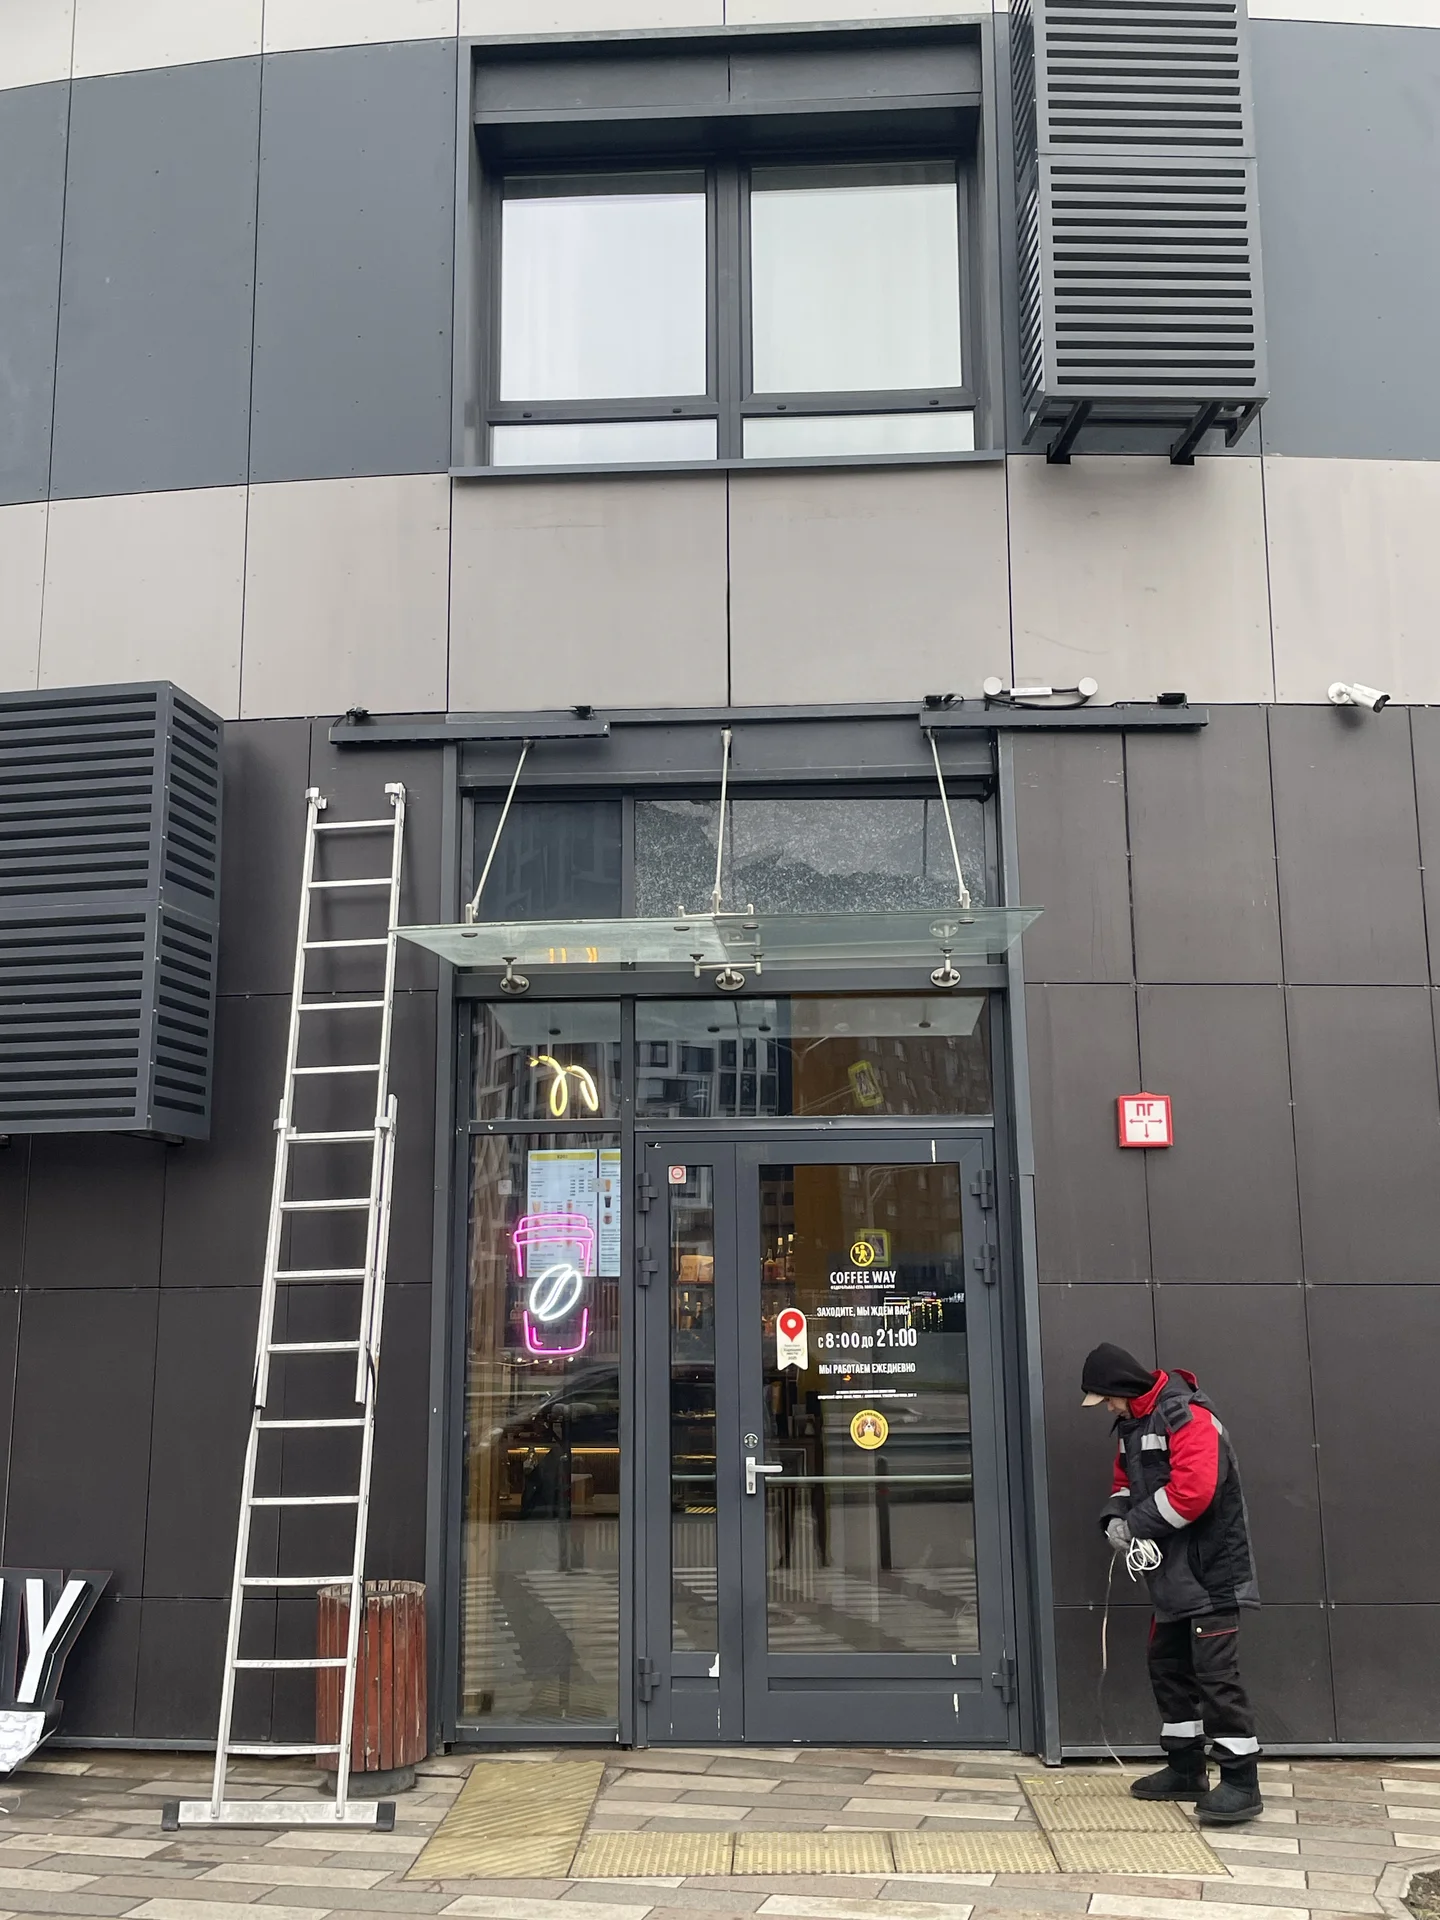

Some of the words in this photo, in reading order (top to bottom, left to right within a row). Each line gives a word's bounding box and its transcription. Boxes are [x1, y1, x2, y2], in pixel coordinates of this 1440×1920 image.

[1136, 1103, 1154, 1116] ПГ
[829, 1271, 870, 1284] COFFEE
[872, 1270, 897, 1283] WAY
[816, 1306, 856, 1317] ЗАХОДИТЕ,
[857, 1306, 870, 1316] МЫ
[825, 1332, 860, 1348] 8:00
[876, 1328, 917, 1347] 21:00
[819, 1364, 832, 1374] МЫ
[833, 1363, 870, 1374] РАБОТАЕМ
[871, 1362, 916, 1374] ЕЖЕДНЕВНО
[0, 1578, 87, 1703] Y
